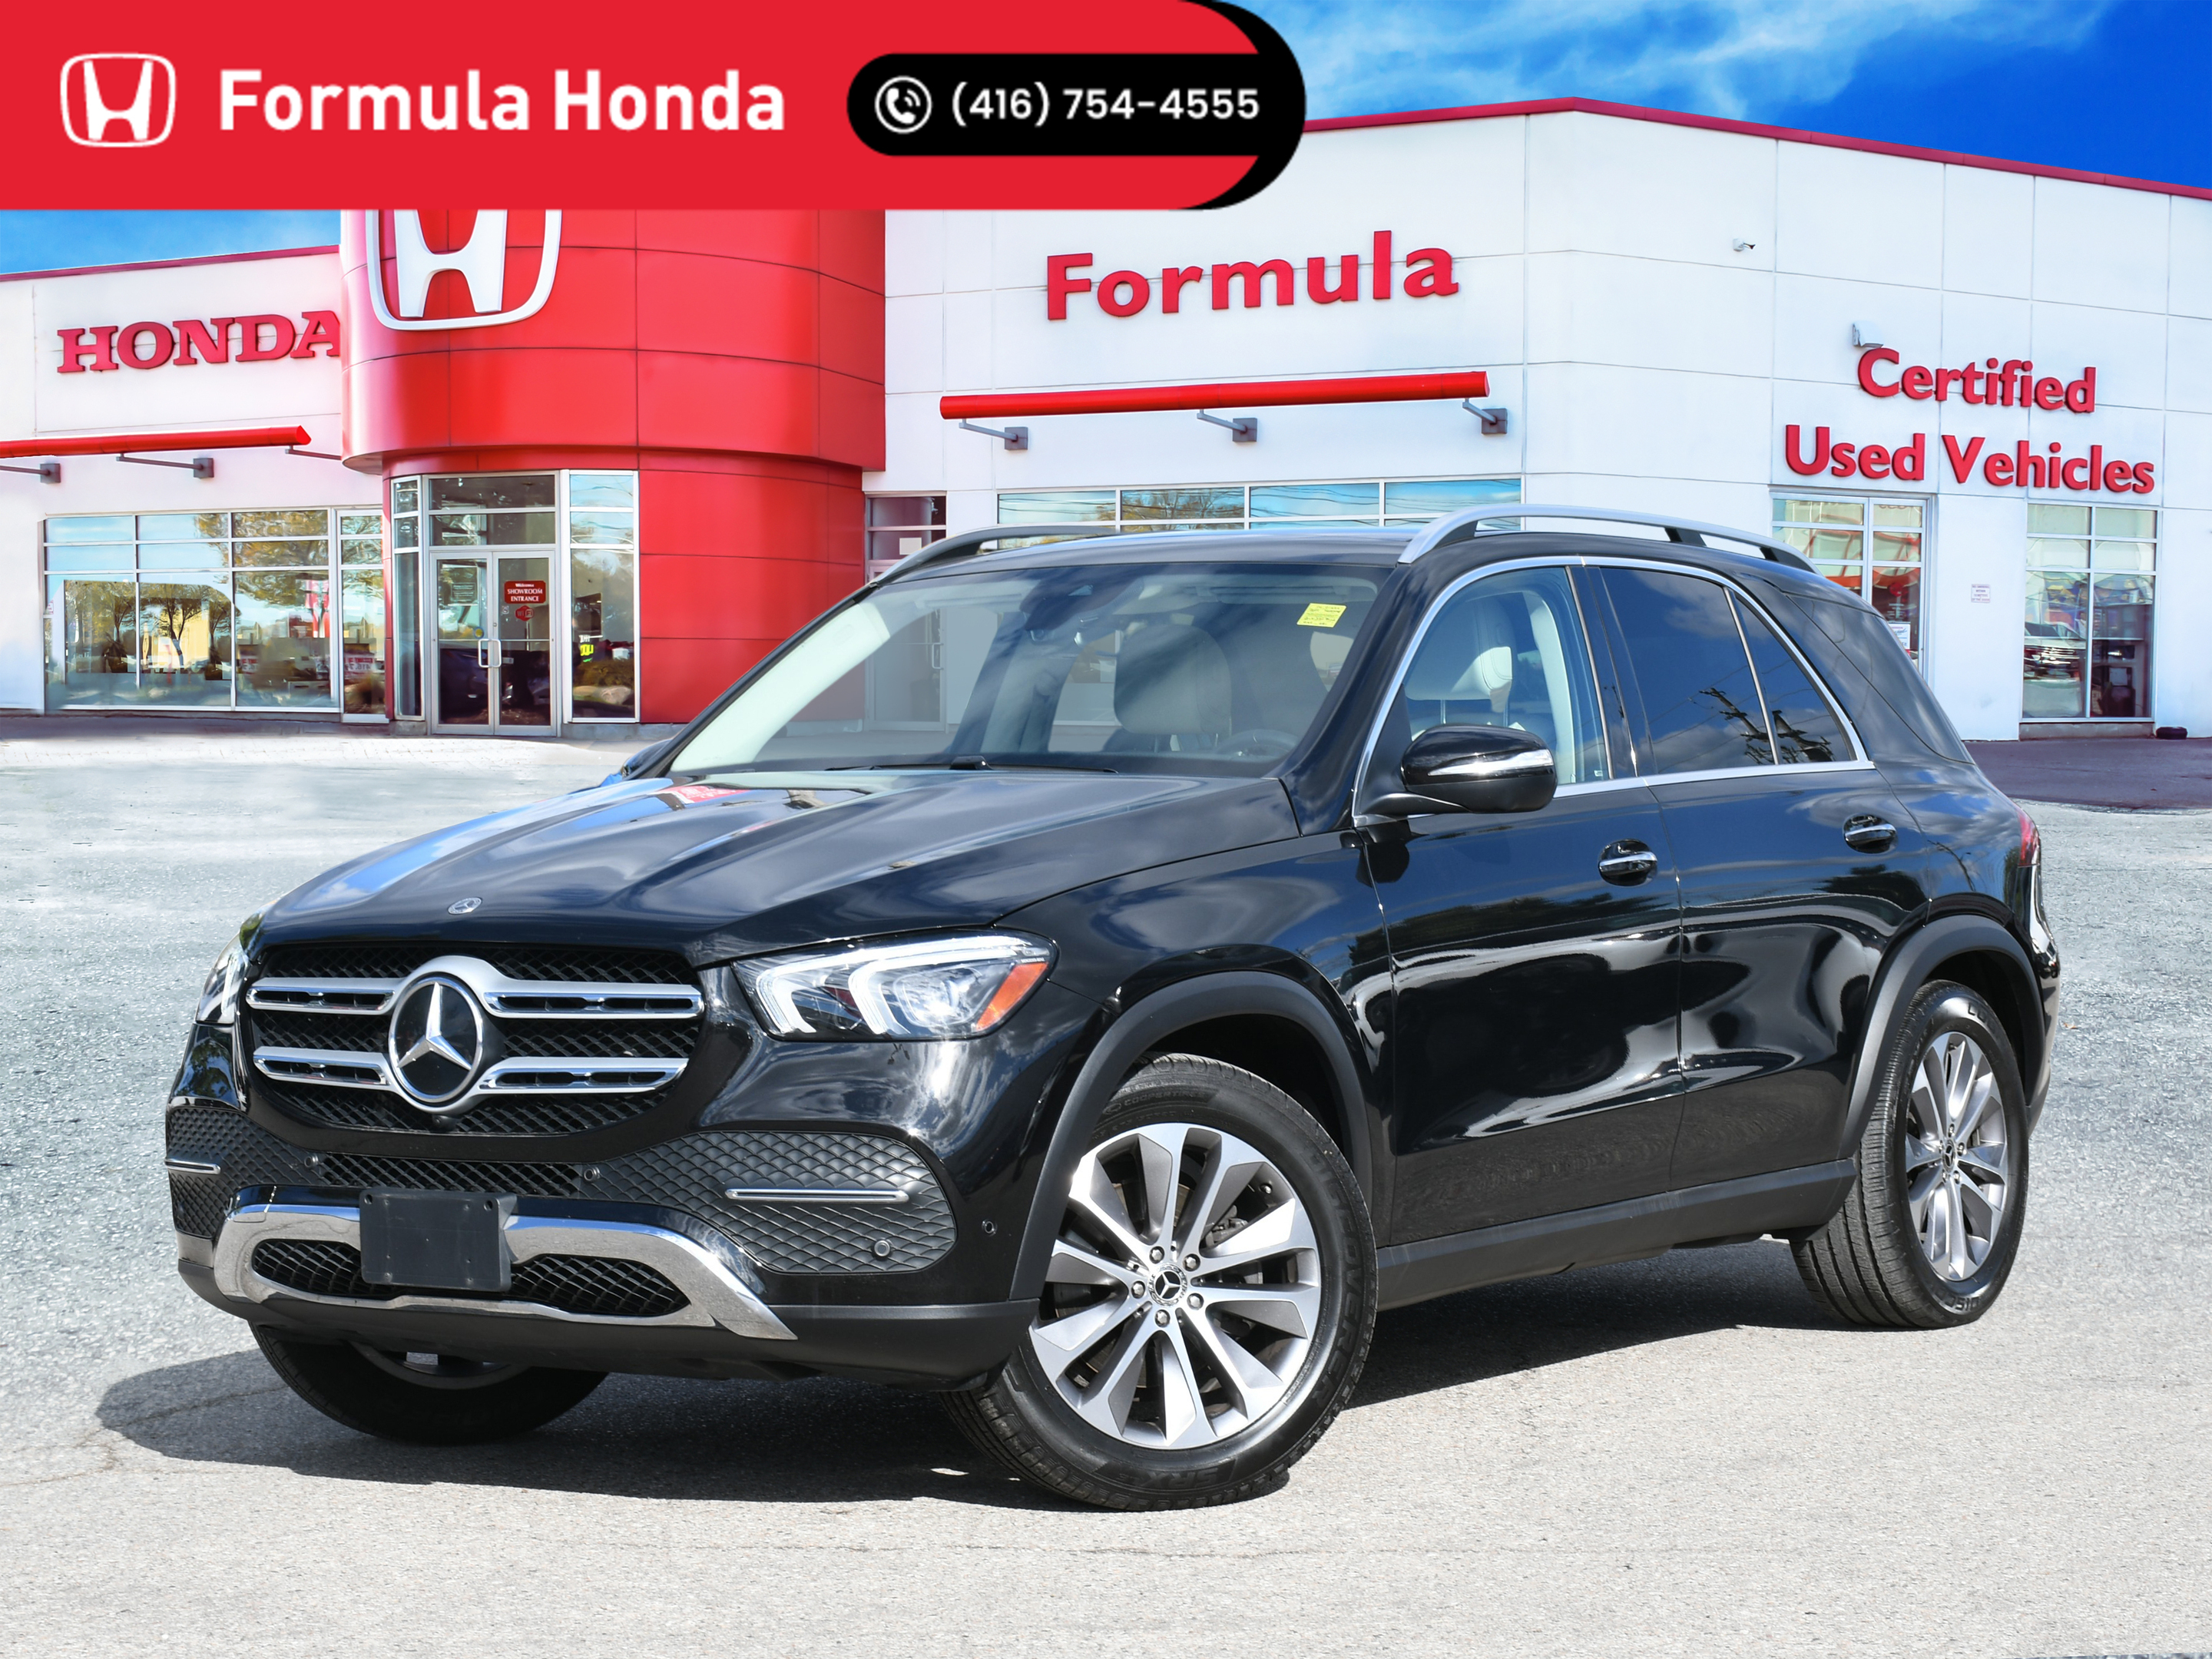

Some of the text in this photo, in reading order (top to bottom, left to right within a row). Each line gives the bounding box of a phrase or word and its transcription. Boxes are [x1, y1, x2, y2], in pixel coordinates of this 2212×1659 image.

[1047, 230, 1459, 320] Formula
[57, 310, 339, 374] HONDA
[1857, 348, 2096, 413] Certified
[1785, 424, 2155, 494] Used Vehicles
